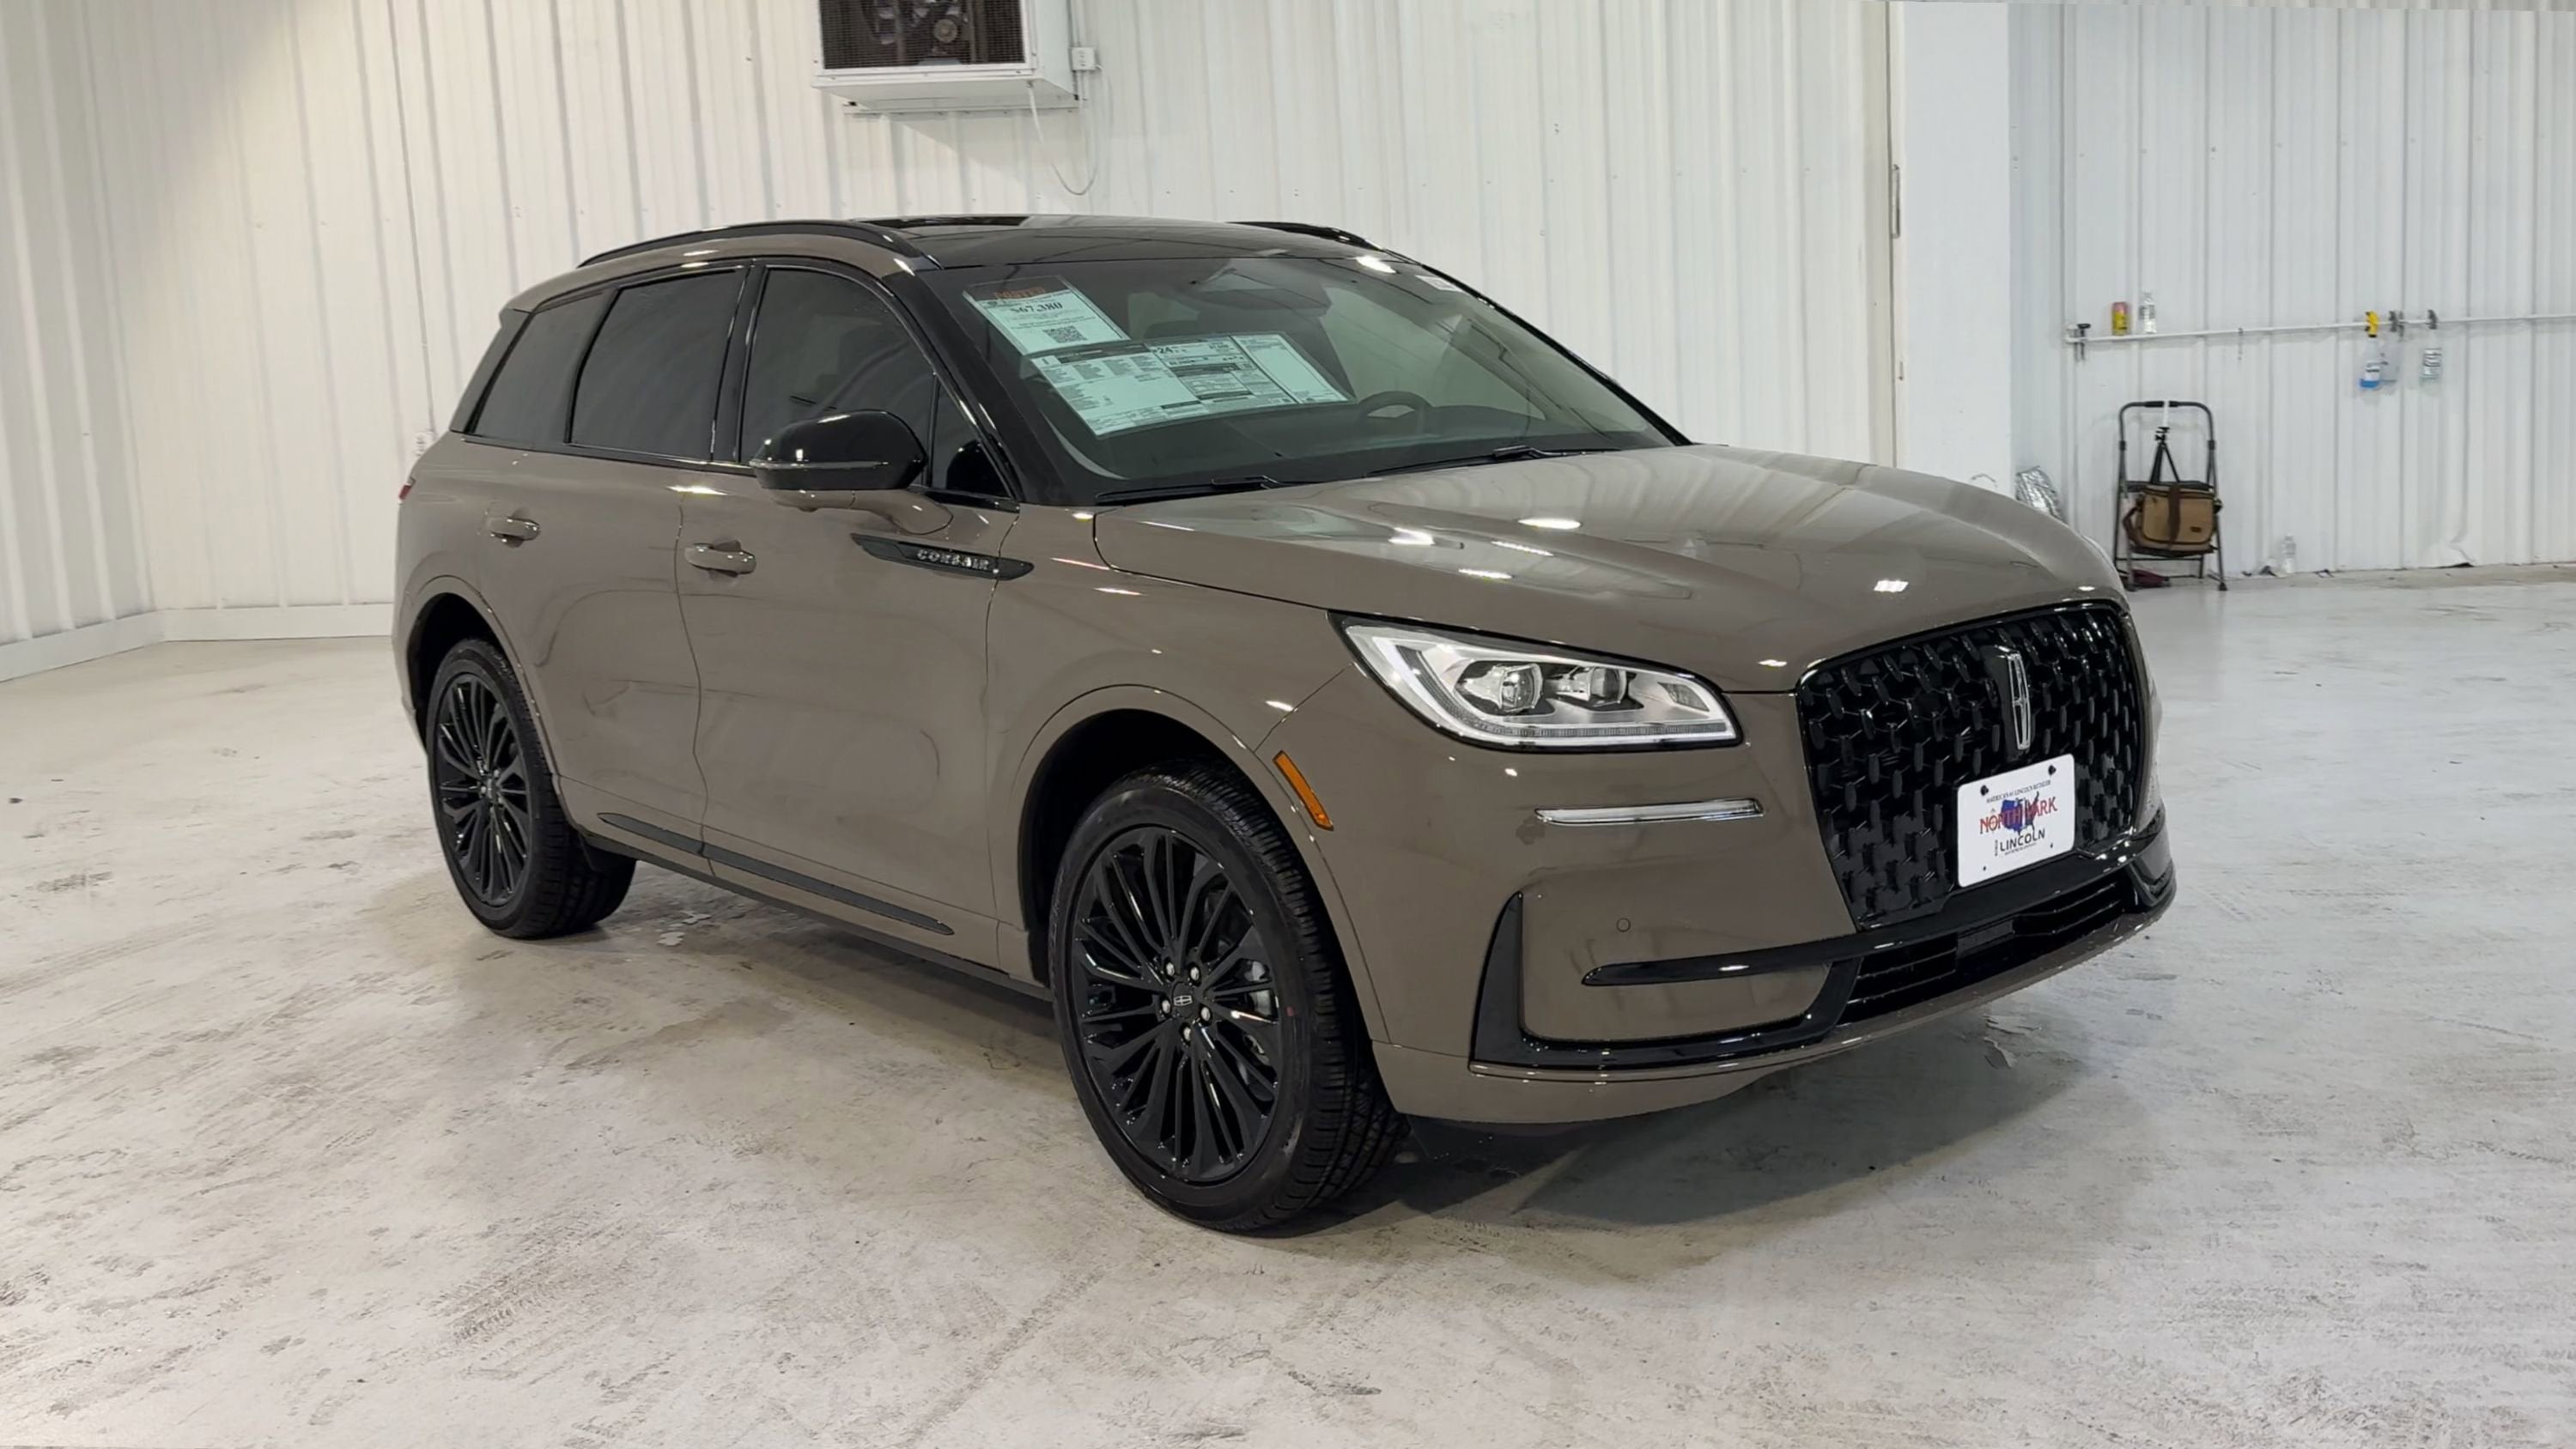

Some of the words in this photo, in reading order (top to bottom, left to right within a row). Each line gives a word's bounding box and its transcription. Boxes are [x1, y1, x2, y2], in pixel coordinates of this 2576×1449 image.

[917, 549, 989, 570] CORSAIR
[1979, 806, 2021, 834] NORTH
[2000, 828, 2045, 852] LINCOLN
